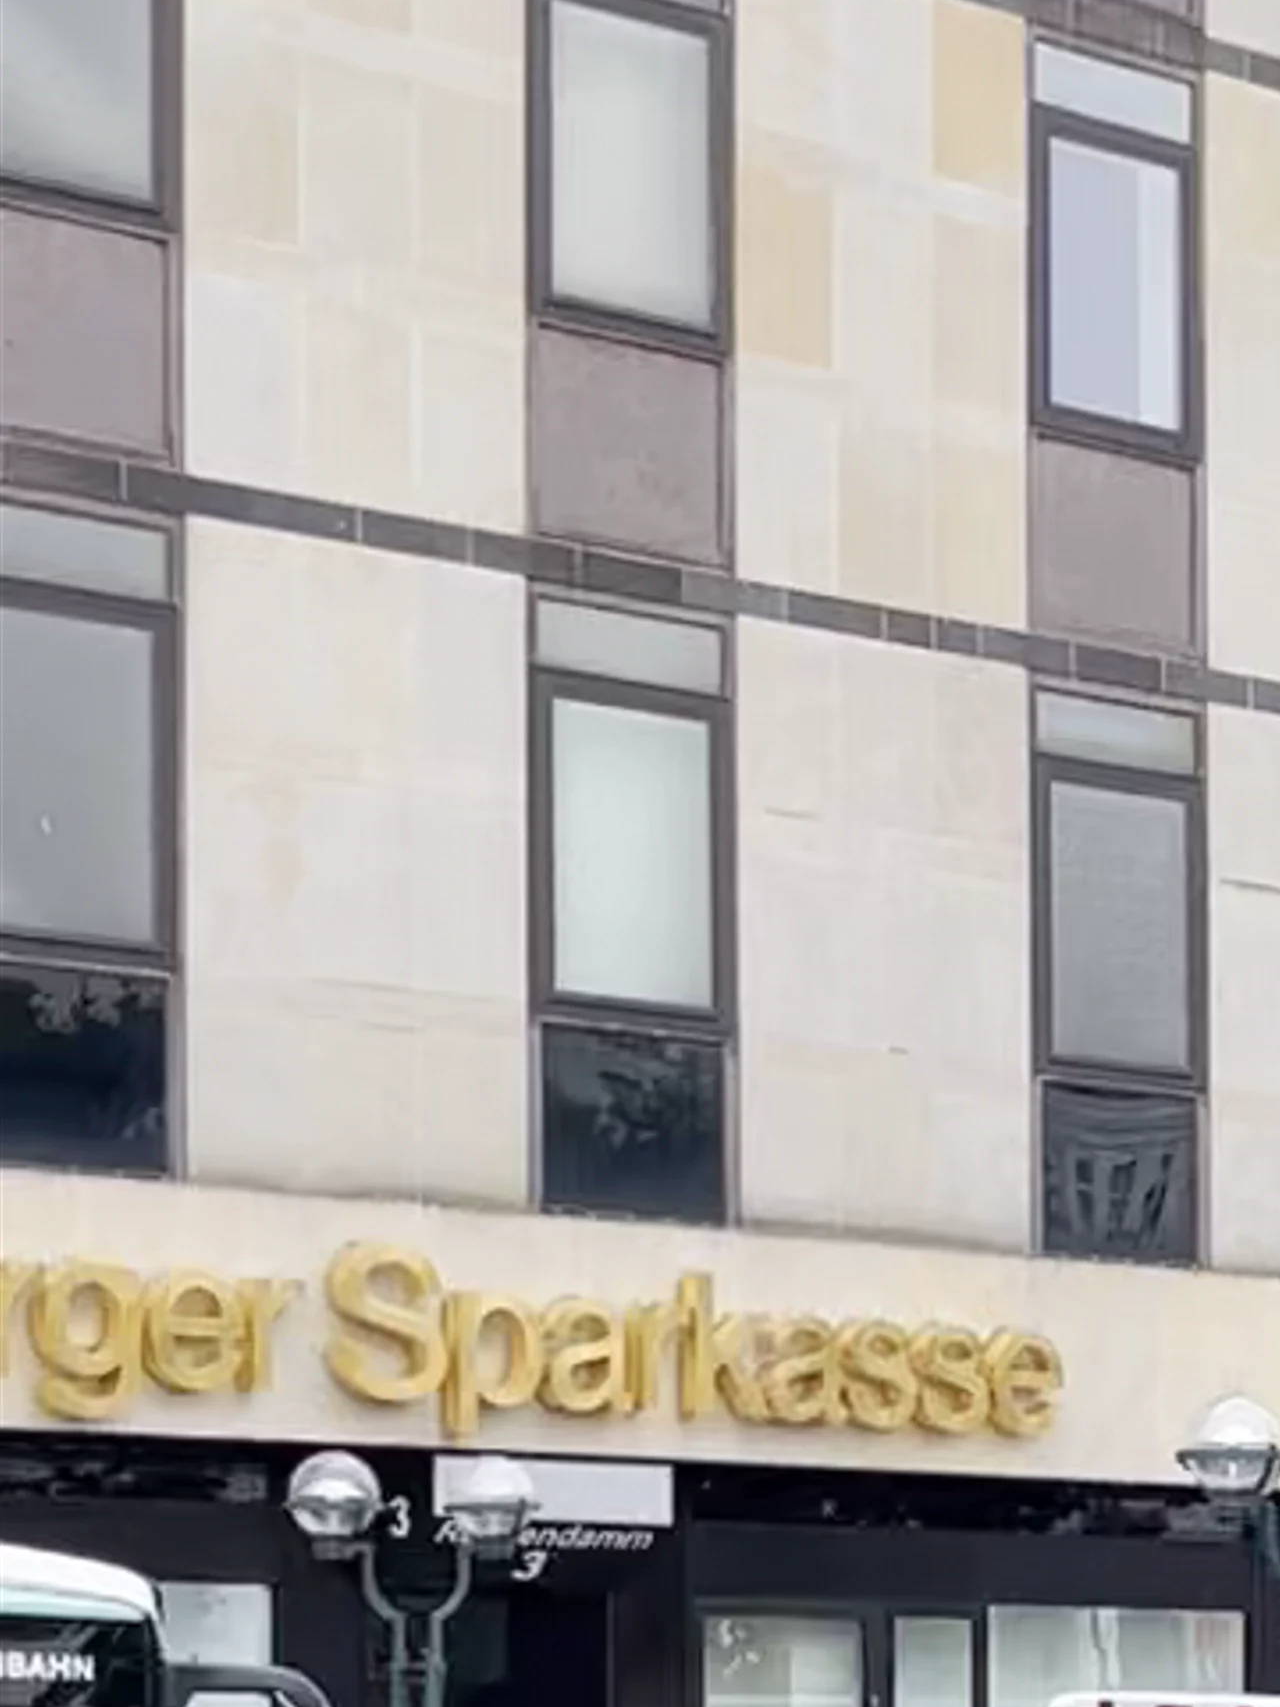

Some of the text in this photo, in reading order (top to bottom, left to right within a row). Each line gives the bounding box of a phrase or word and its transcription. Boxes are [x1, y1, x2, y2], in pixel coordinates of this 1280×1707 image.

[325, 1241, 1063, 1437] Sparkasse
[511, 1551, 548, 1581] 3
[0, 1650, 95, 1682] BAHN
